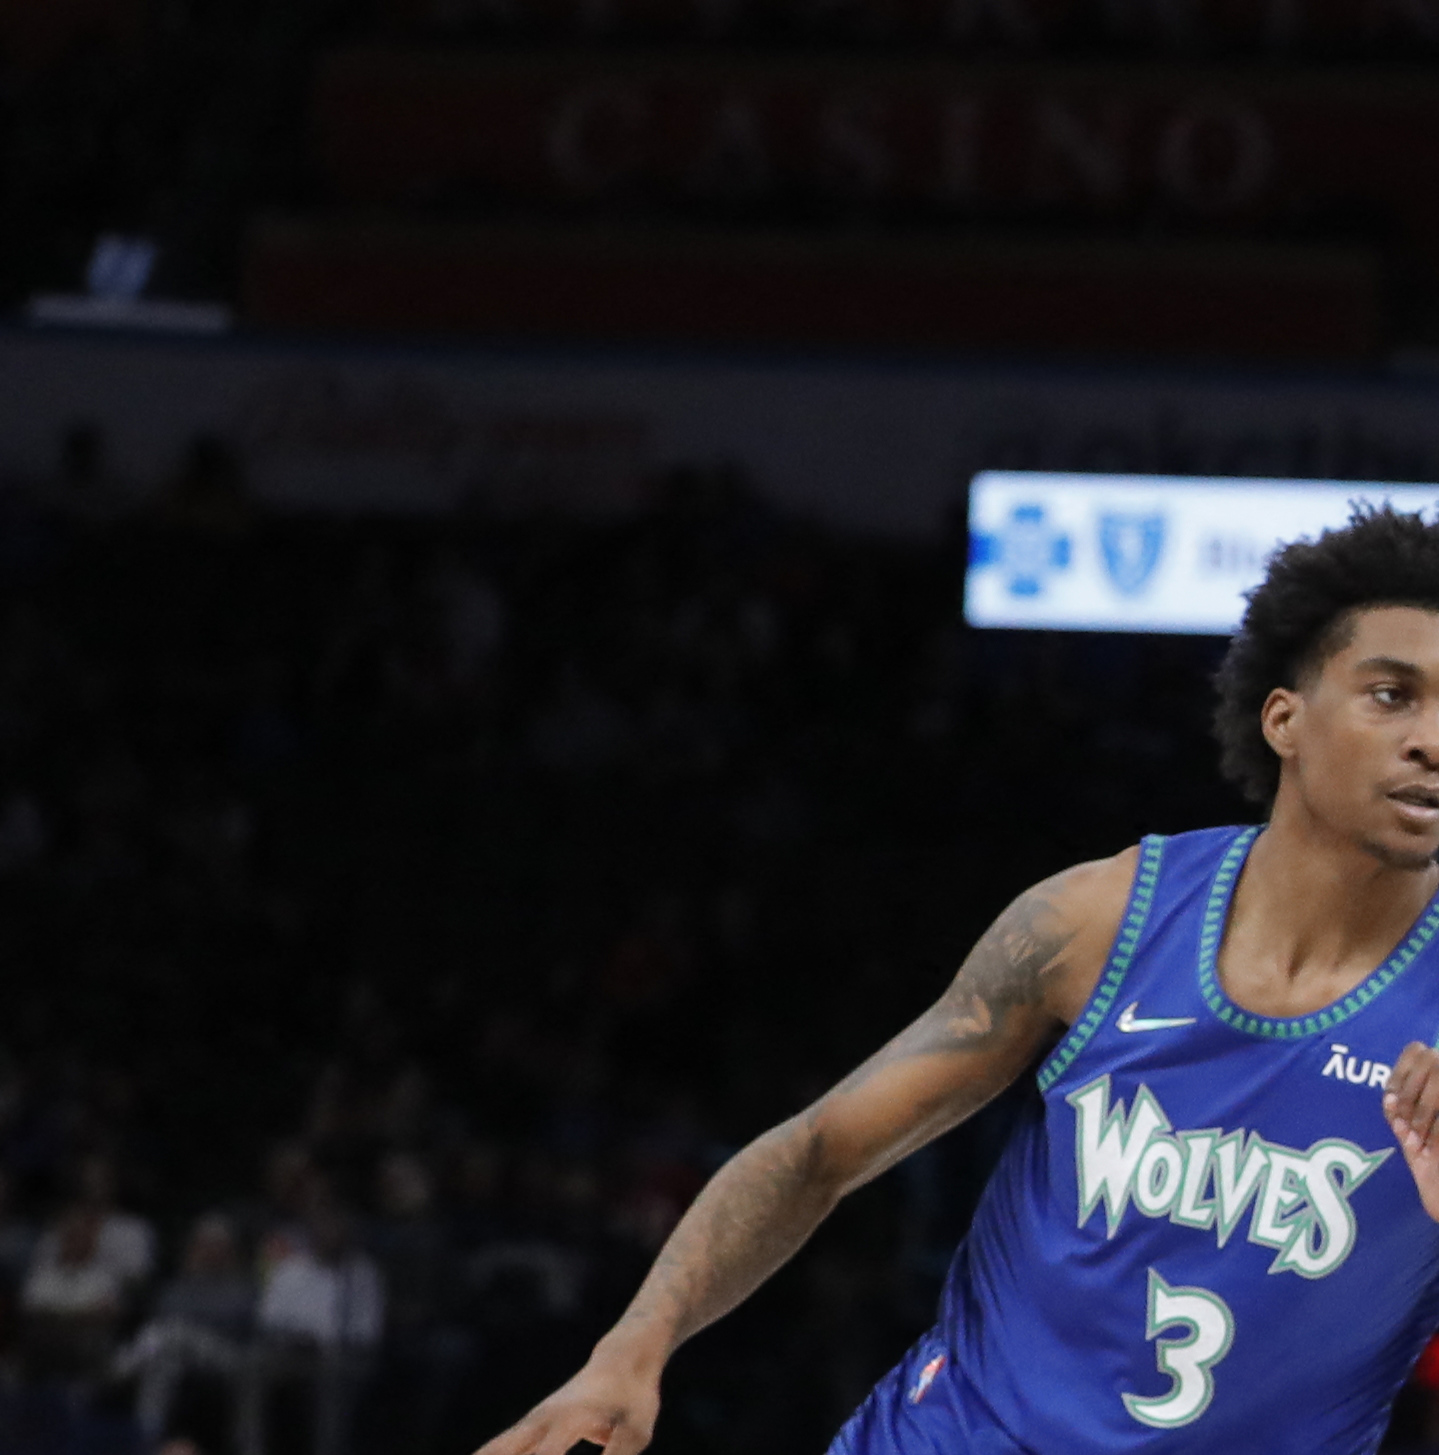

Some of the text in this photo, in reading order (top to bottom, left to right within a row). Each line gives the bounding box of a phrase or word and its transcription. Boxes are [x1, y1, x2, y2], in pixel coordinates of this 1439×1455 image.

[543, 82, 1278, 212] CASINO
[1321, 1043, 1392, 1091] ĀUR
[1065, 1073, 1395, 1280] WOLVES
[1121, 1266, 1236, 1430] 3
